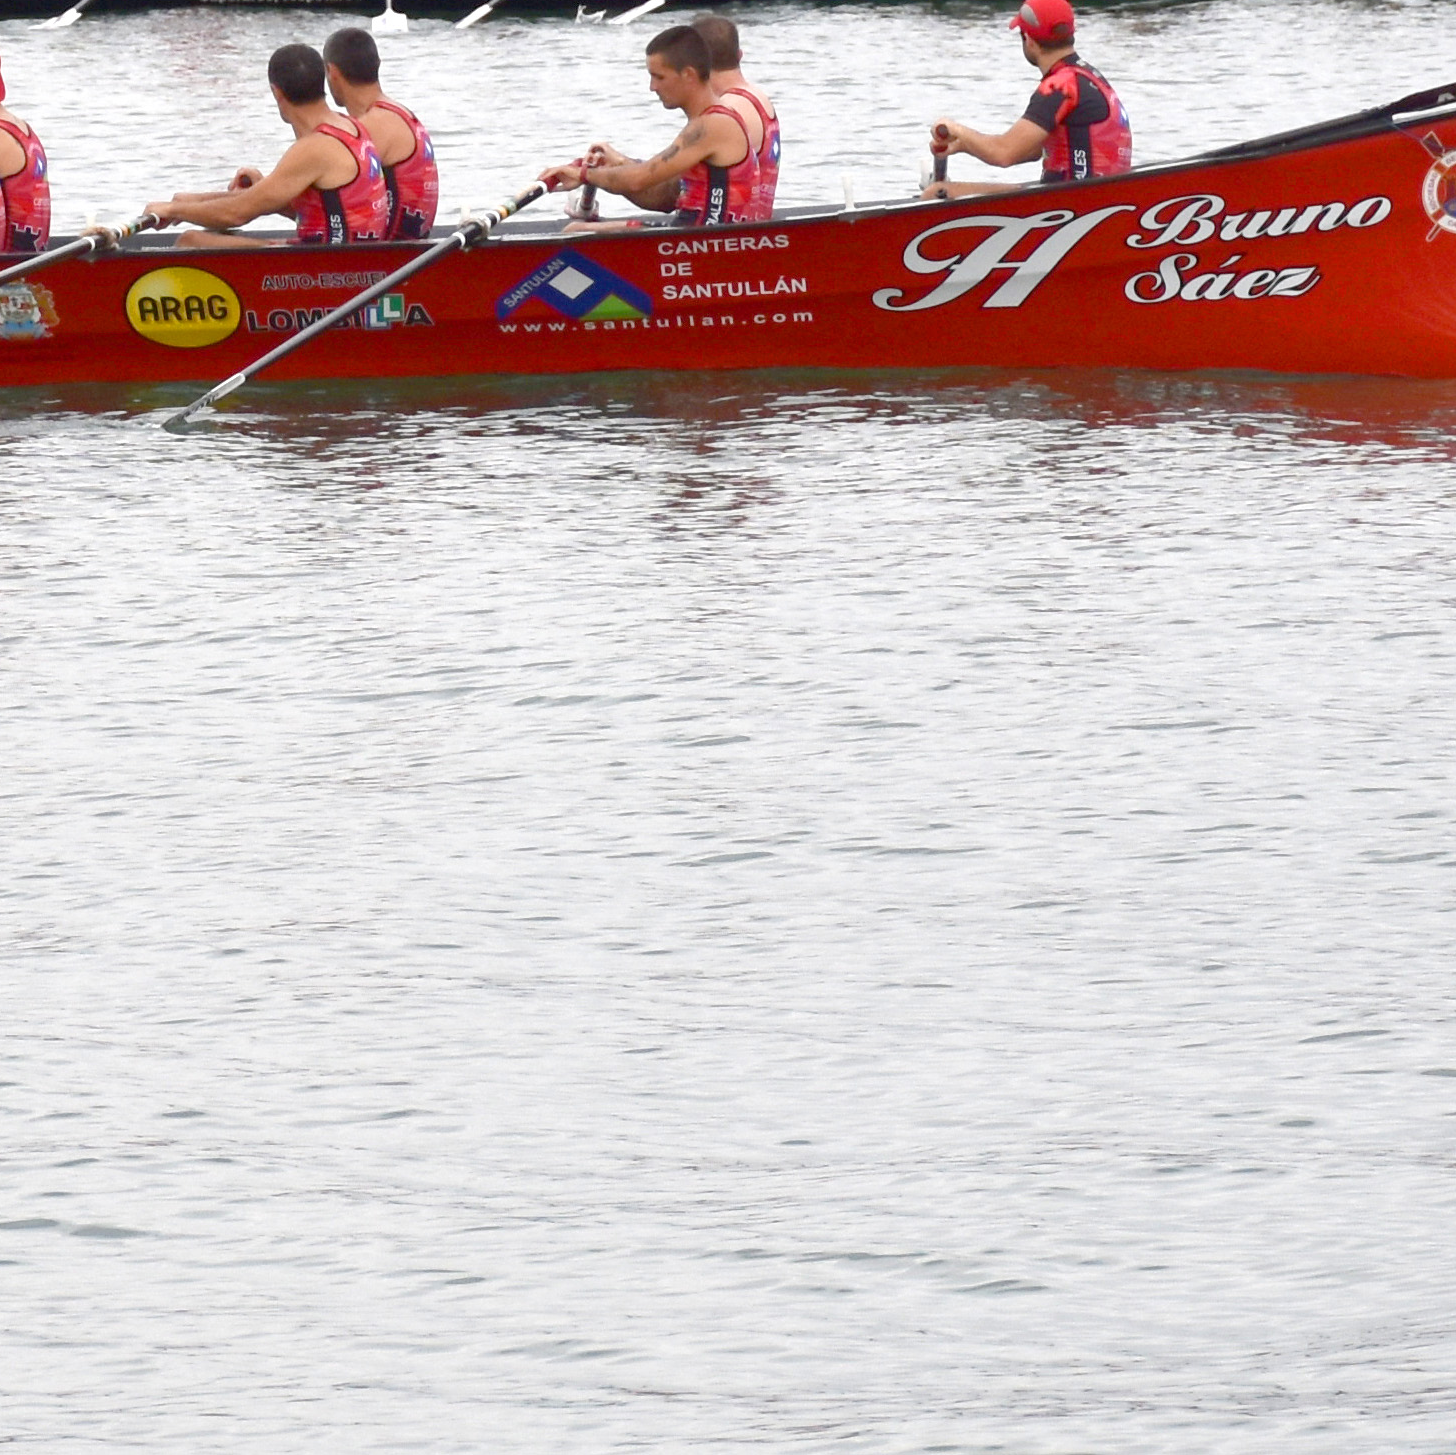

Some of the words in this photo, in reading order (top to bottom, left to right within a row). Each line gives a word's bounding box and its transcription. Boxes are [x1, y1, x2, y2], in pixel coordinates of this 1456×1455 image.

[1125, 193, 1393, 249] Bruno
[658, 234, 790, 256] CANTERAS
[261, 271, 409, 291] AUTO-ESCUE
[660, 263, 693, 277] DE
[1123, 252, 1321, 305] Sáez
[662, 276, 808, 300] SANTULLÁN
[137, 294, 228, 322] ARAG
[499, 309, 814, 333] www.santullan.com
